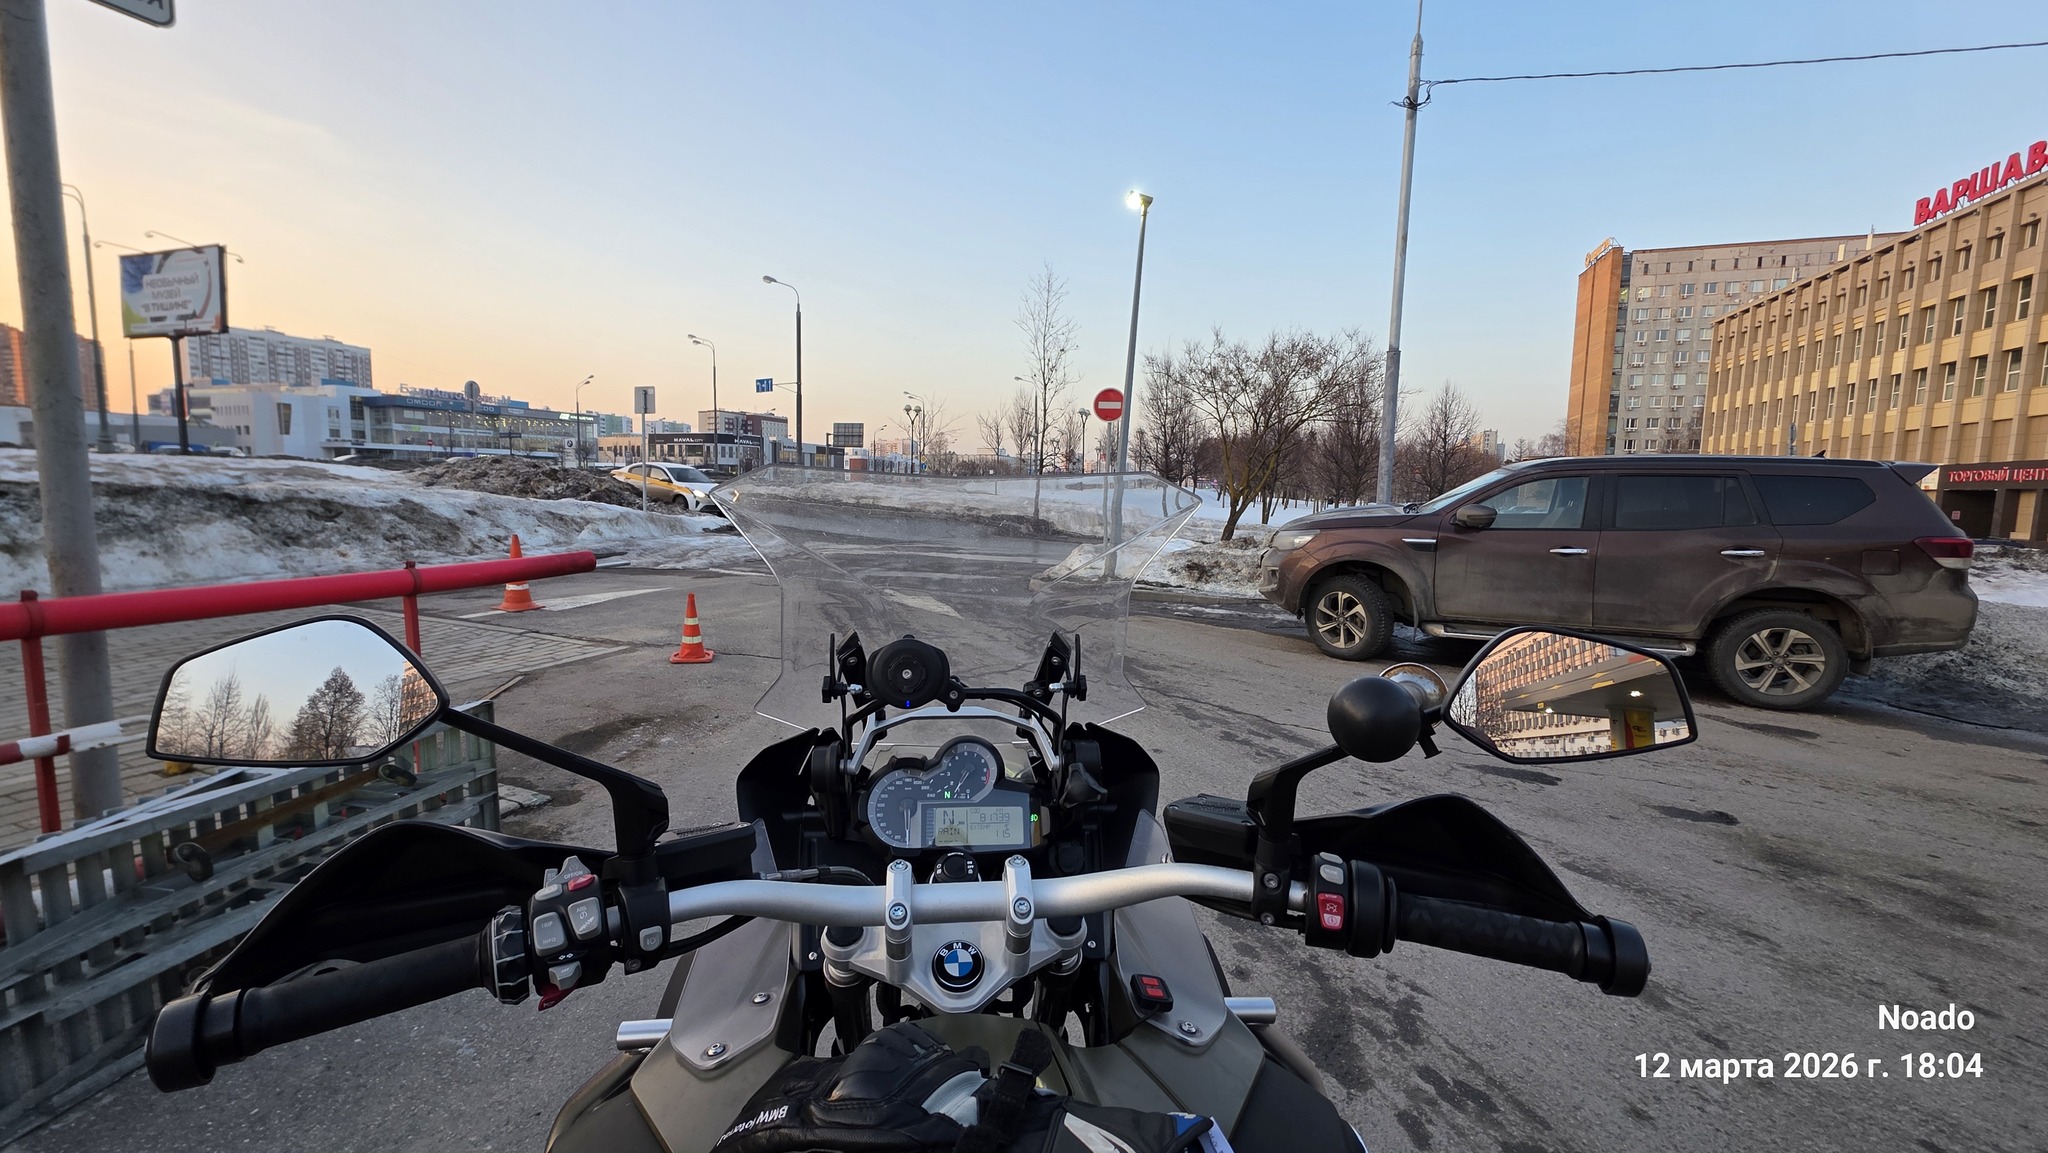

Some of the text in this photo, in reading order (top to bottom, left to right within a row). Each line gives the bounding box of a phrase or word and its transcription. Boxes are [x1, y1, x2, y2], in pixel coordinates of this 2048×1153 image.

[1914, 140, 2048, 226] ВАРШАВ
[145, 272, 199, 289] НЕОБЫЧНЫЙ
[151, 287, 182, 300] МУЗЕЙ
[1948, 466, 2009, 482] ТОРГОВЫЙ
[944, 791, 951, 799] N
[943, 810, 955, 825] N
[938, 827, 960, 836] RAIN
[939, 942, 977, 957] BMW
[756, 1105, 789, 1125] BMW
